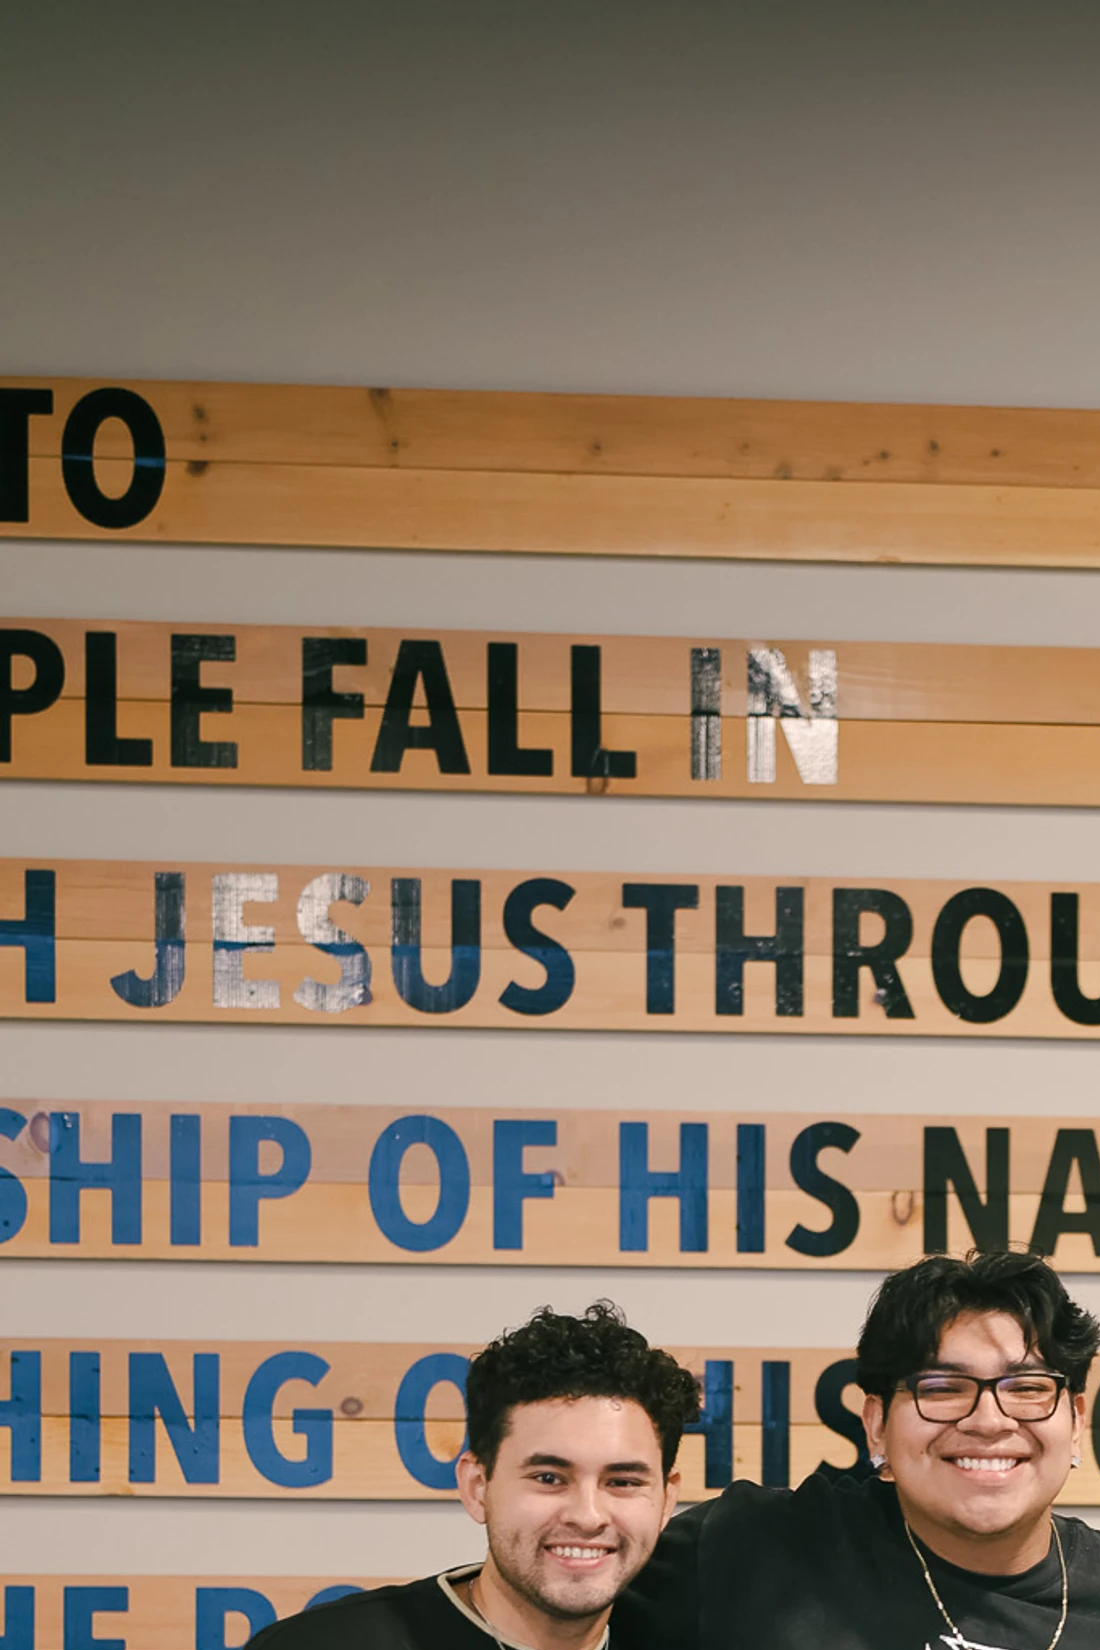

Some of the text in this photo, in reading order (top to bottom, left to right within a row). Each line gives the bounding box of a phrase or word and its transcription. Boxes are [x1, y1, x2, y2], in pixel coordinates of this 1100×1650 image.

[0, 387, 166, 529] TO
[0, 629, 839, 785] PLE FALL IN
[110, 871, 577, 1016] JESUS
[368, 1115, 557, 1252] OF
[619, 1121, 862, 1257] HIS
